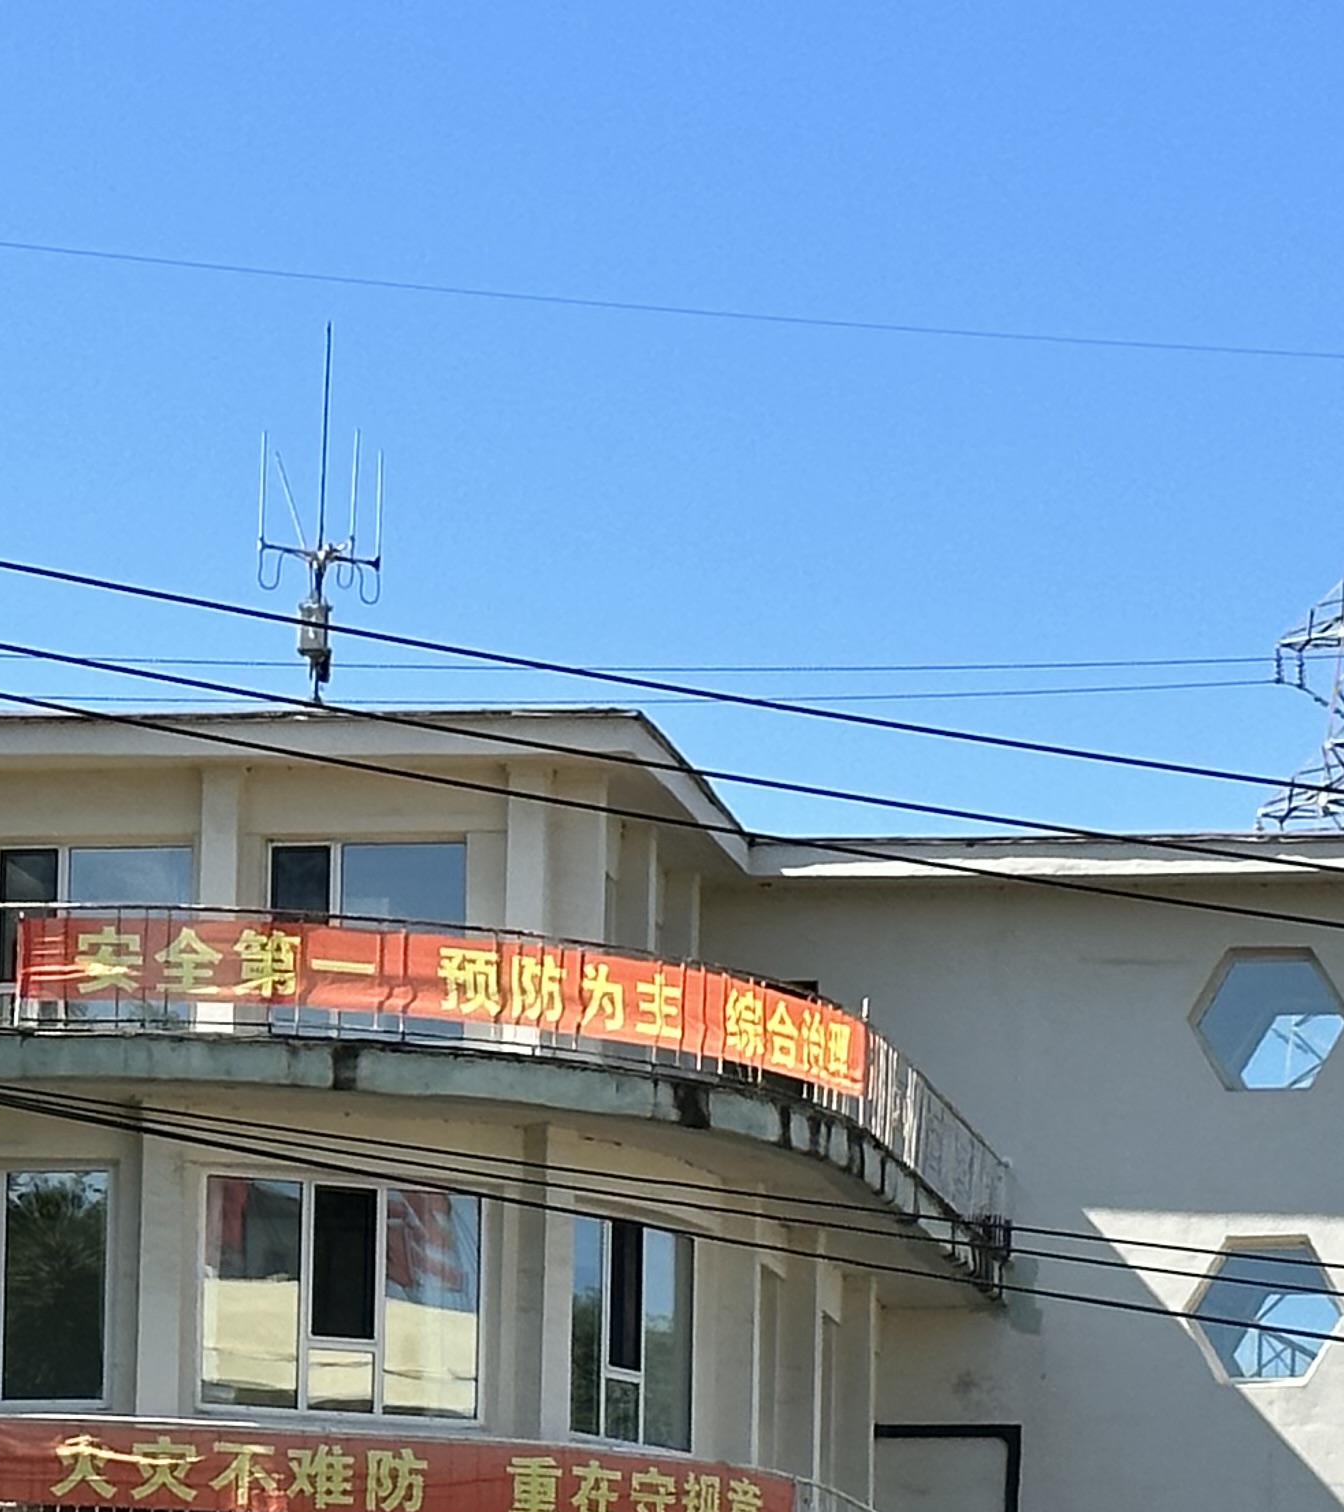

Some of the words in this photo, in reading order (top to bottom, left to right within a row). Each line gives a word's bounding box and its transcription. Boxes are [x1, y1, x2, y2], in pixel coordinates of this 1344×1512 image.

[76, 926, 376, 998] 安全第一
[437, 945, 683, 1039] 预防为主
[724, 987, 851, 1078] 综合治理
